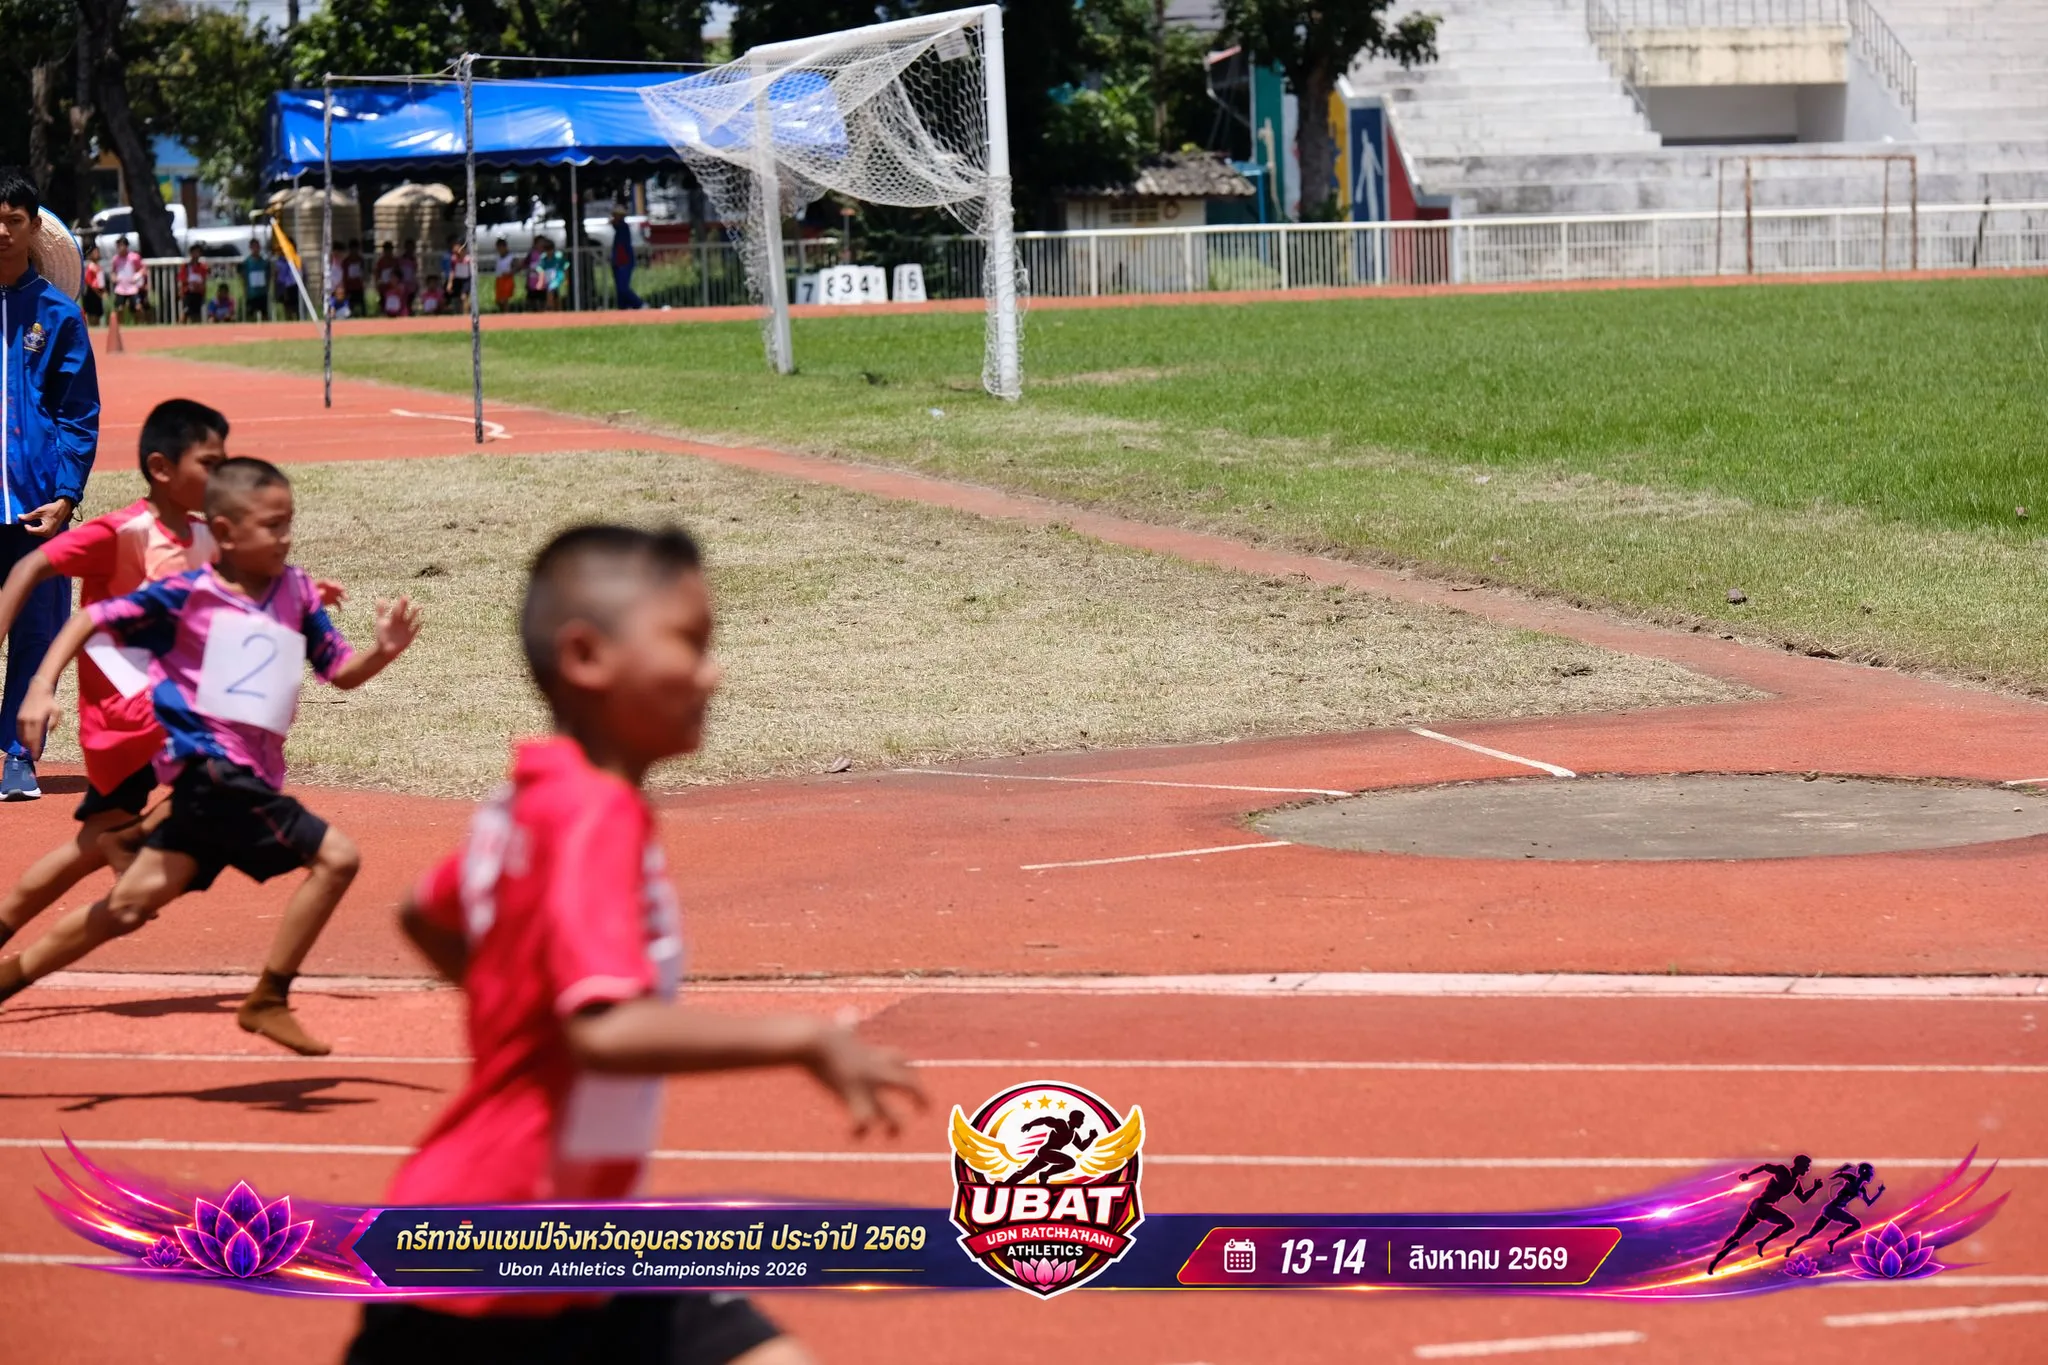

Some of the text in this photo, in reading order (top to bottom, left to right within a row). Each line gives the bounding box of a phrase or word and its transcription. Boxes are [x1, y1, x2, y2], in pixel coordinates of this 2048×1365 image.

[841, 273, 853, 294] 3
[860, 275, 869, 293] 4
[908, 271, 918, 291] 6
[803, 283, 814, 303] 7
[224, 632, 279, 700] 2
